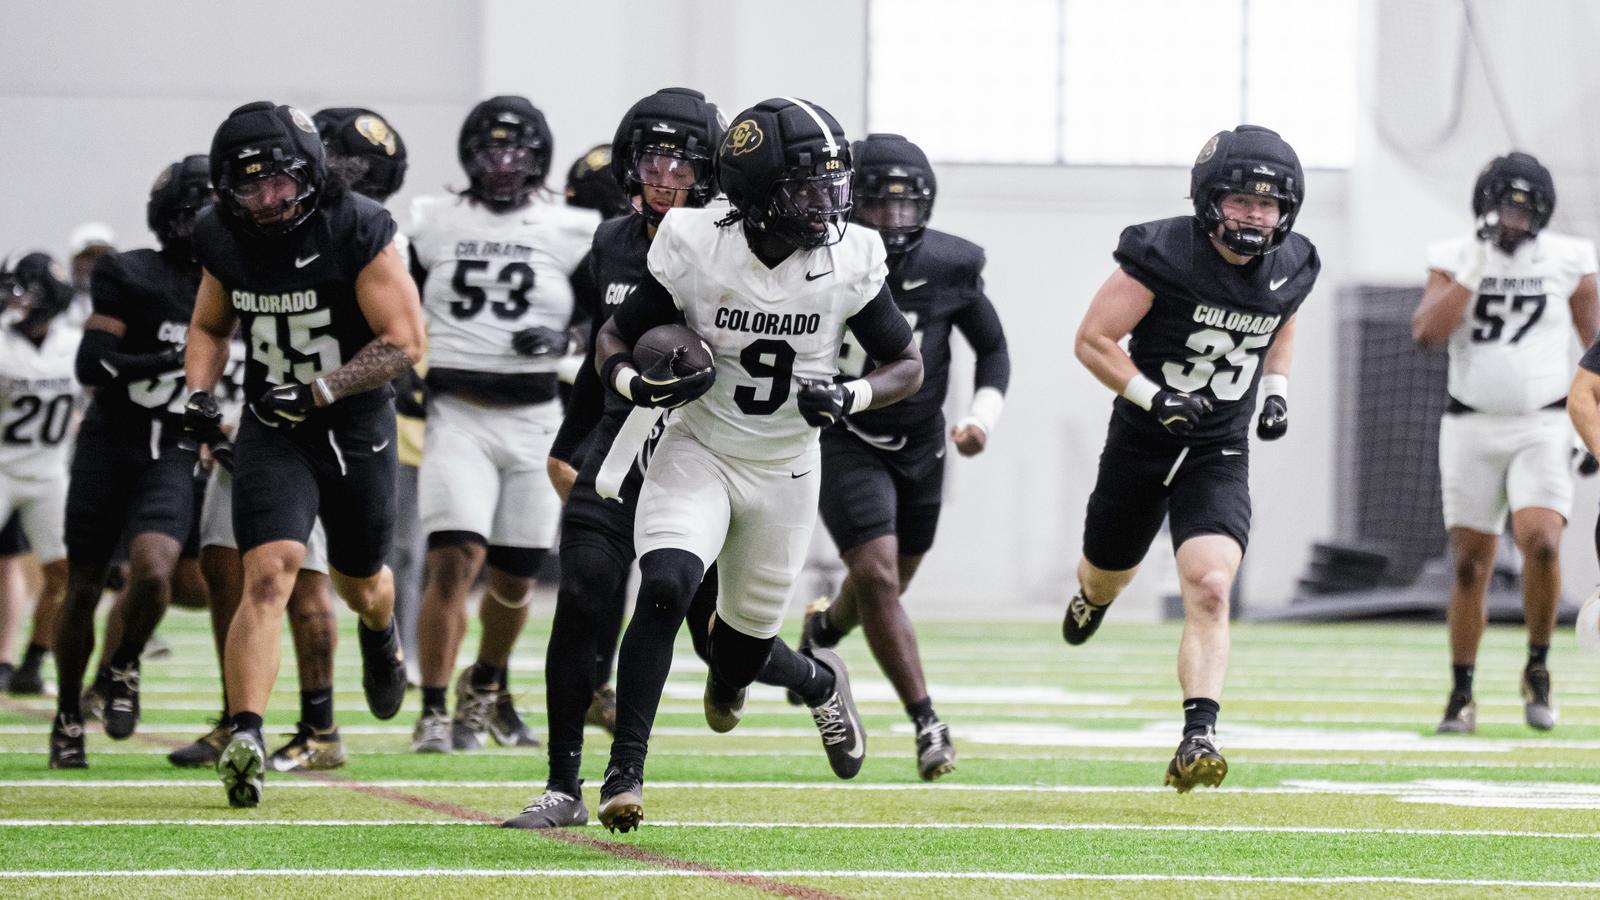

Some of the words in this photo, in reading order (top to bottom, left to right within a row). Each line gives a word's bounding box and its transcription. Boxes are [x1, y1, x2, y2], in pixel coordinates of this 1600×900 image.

[232, 289, 317, 313] COLORADO
[450, 260, 535, 320] 53
[715, 307, 820, 335] COLORADO
[1192, 304, 1281, 335] COLORADO
[1471, 294, 1547, 343] 57
[251, 308, 341, 385] 45
[1161, 328, 1274, 401] 35
[733, 339, 796, 415] 9
[4, 395, 72, 446] 20
